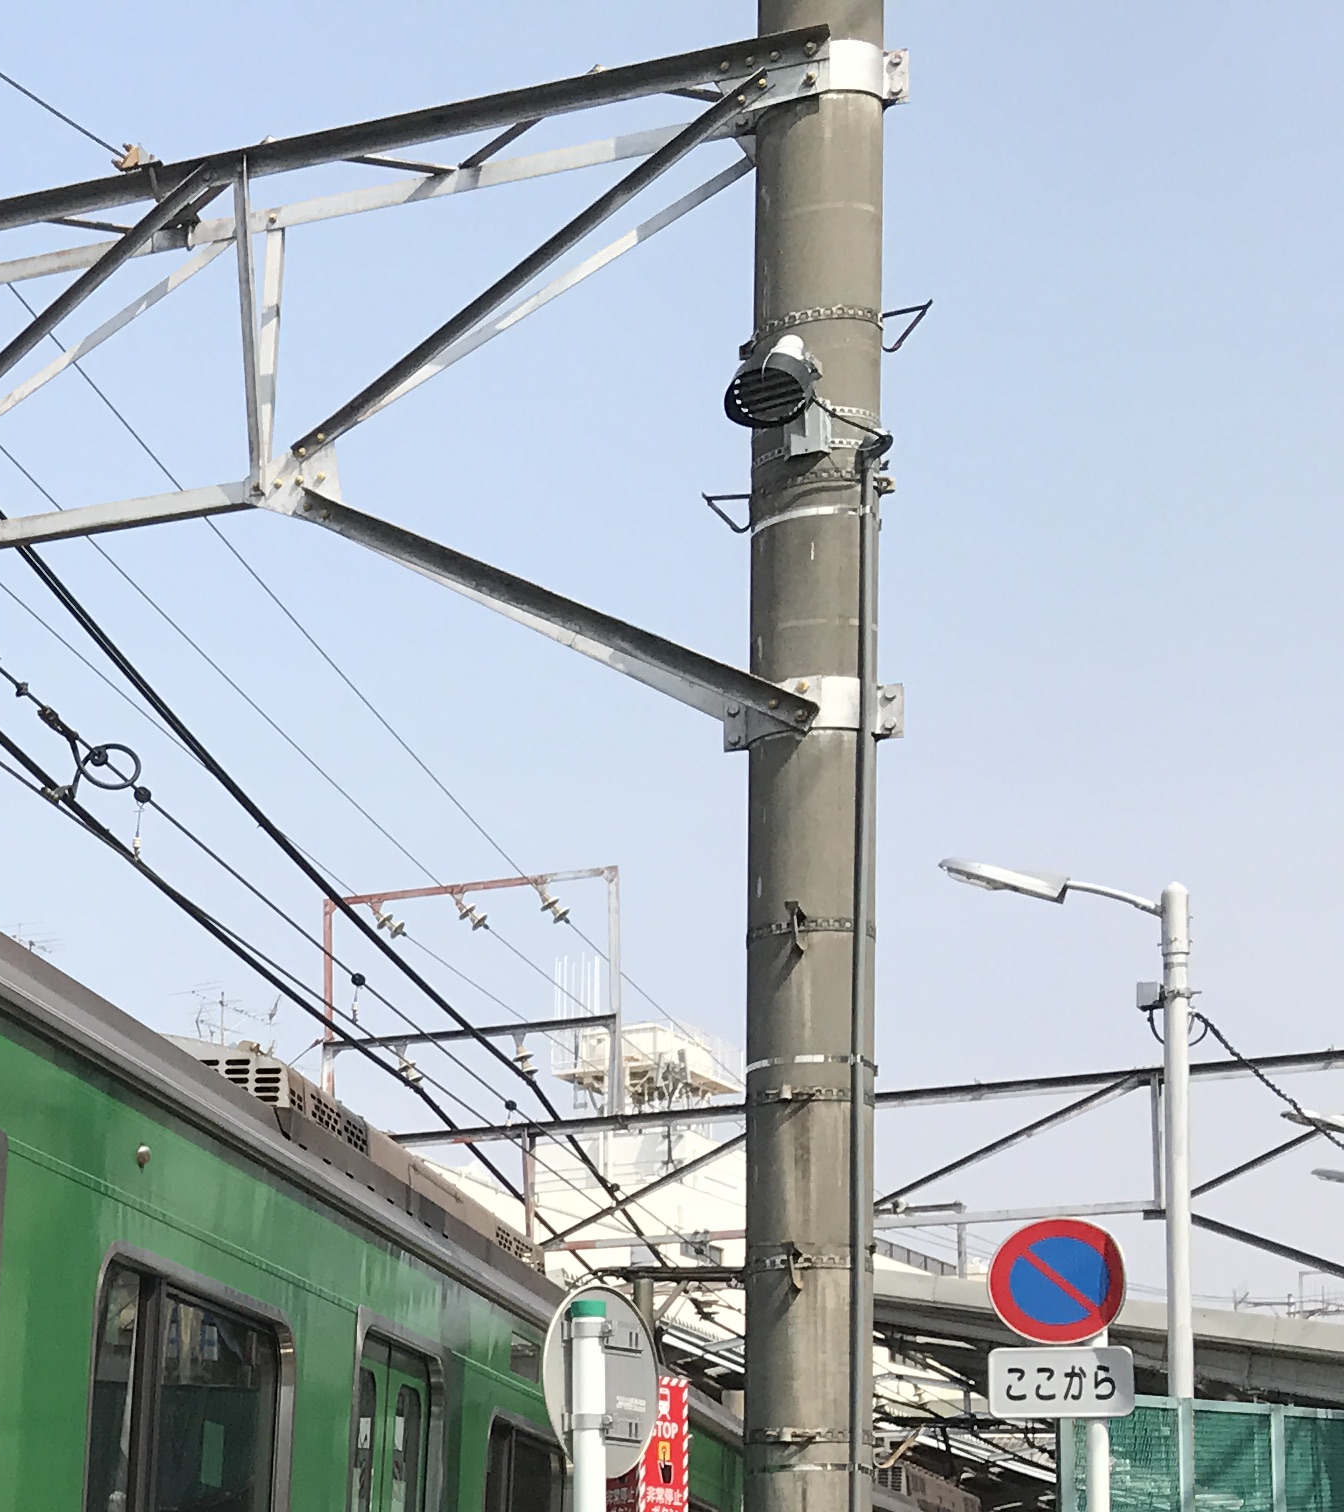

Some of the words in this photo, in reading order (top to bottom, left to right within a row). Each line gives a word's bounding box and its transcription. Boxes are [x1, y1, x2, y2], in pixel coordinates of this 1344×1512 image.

[1006, 1365, 1116, 1401] ここから
[646, 1485, 683, 1506] 非常停止
